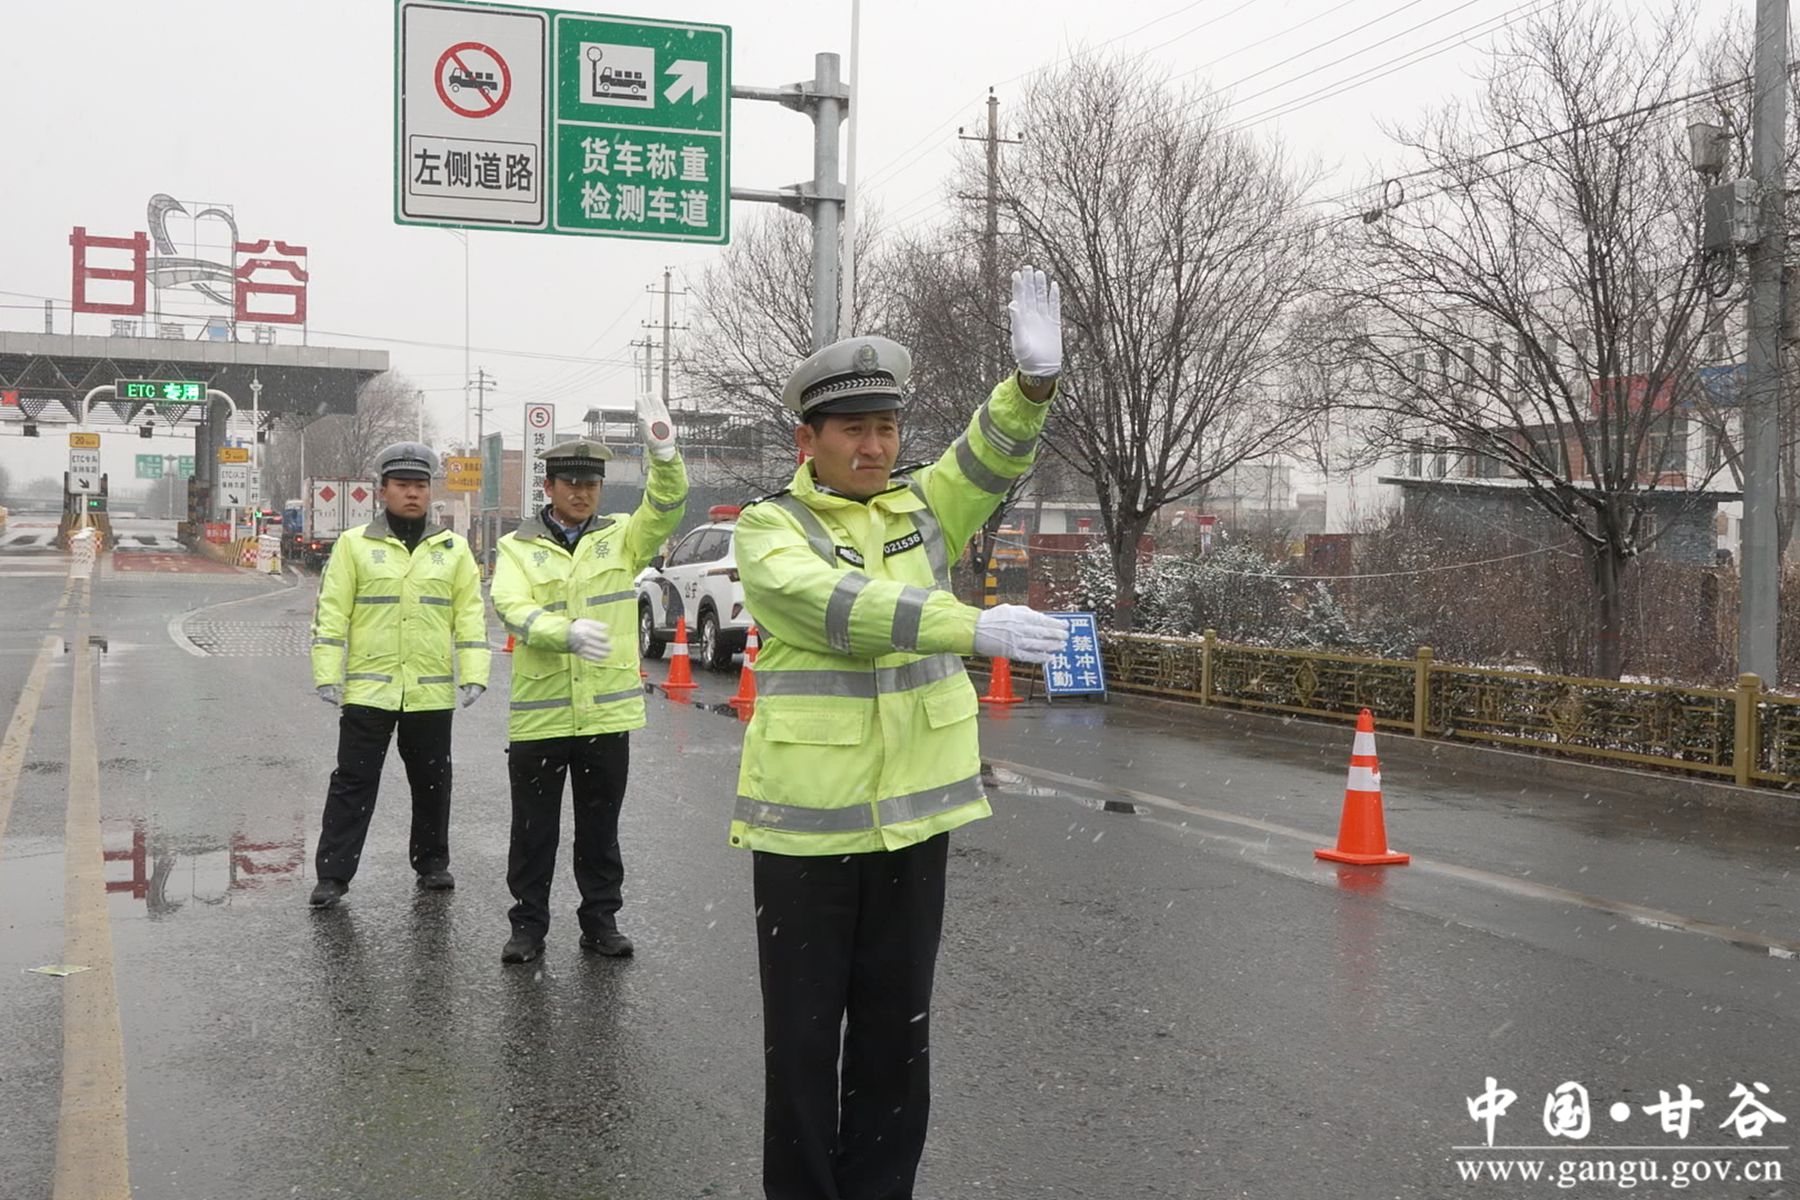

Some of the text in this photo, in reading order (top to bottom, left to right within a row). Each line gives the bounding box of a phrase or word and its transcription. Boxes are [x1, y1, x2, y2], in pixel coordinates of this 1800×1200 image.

[414, 148, 534, 192] 左侧道路
[580, 135, 710, 183] 货车称重
[580, 180, 710, 228] 检测车道
[127, 383, 200, 400] ETC 专用
[535, 412, 545, 423] 5
[1051, 650, 1073, 687] 执勤
[1070, 618, 1098, 687] 严禁冲卡
